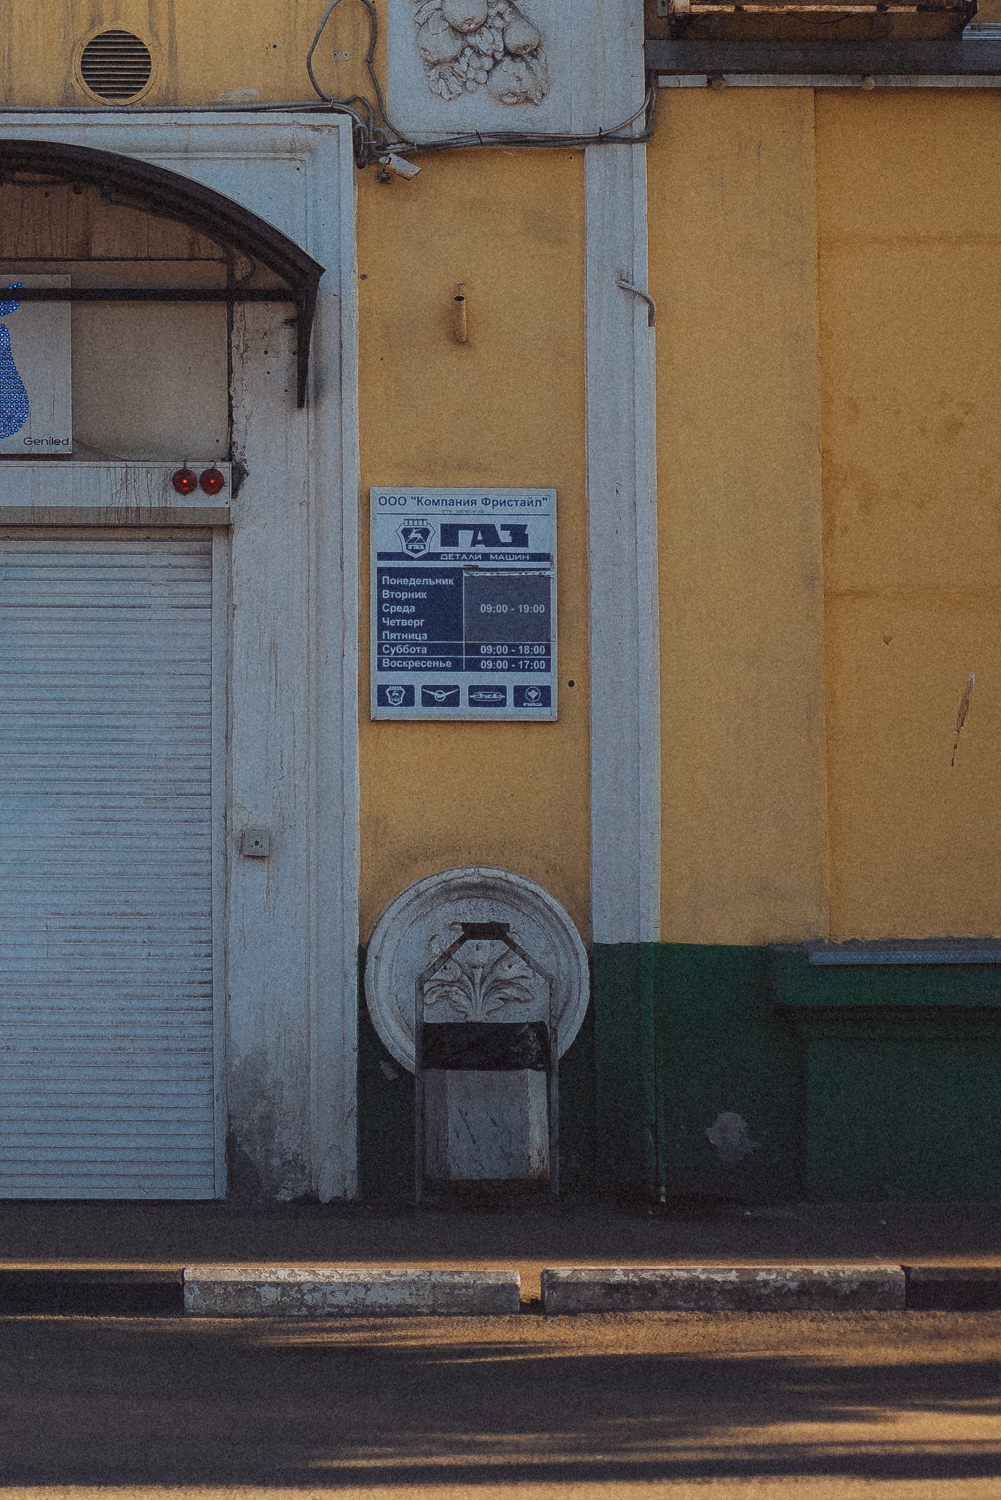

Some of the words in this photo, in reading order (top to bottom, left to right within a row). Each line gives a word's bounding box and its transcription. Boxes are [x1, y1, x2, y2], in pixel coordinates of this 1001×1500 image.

[23, 436, 70, 446] Geniled
[378, 496, 407, 506] ООО
[411, 496, 478, 507] "Компания
[481, 496, 548, 509] Фристайл"
[440, 523, 529, 548] ГАЗ
[382, 576, 454, 586] Понедельник
[382, 590, 427, 601] Вторник
[382, 604, 416, 614] Среда
[480, 604, 508, 614] 09:00
[518, 604, 546, 614] 19:00
[382, 617, 425, 628] Четверг
[382, 631, 428, 642] Пятница
[382, 644, 428, 656] Суббота
[480, 645, 509, 655] 09:00
[518, 645, 546, 655] 18:00
[382, 658, 452, 669] Воскресенье
[480, 660, 509, 670] 09:00
[518, 660, 546, 670] 17:00
